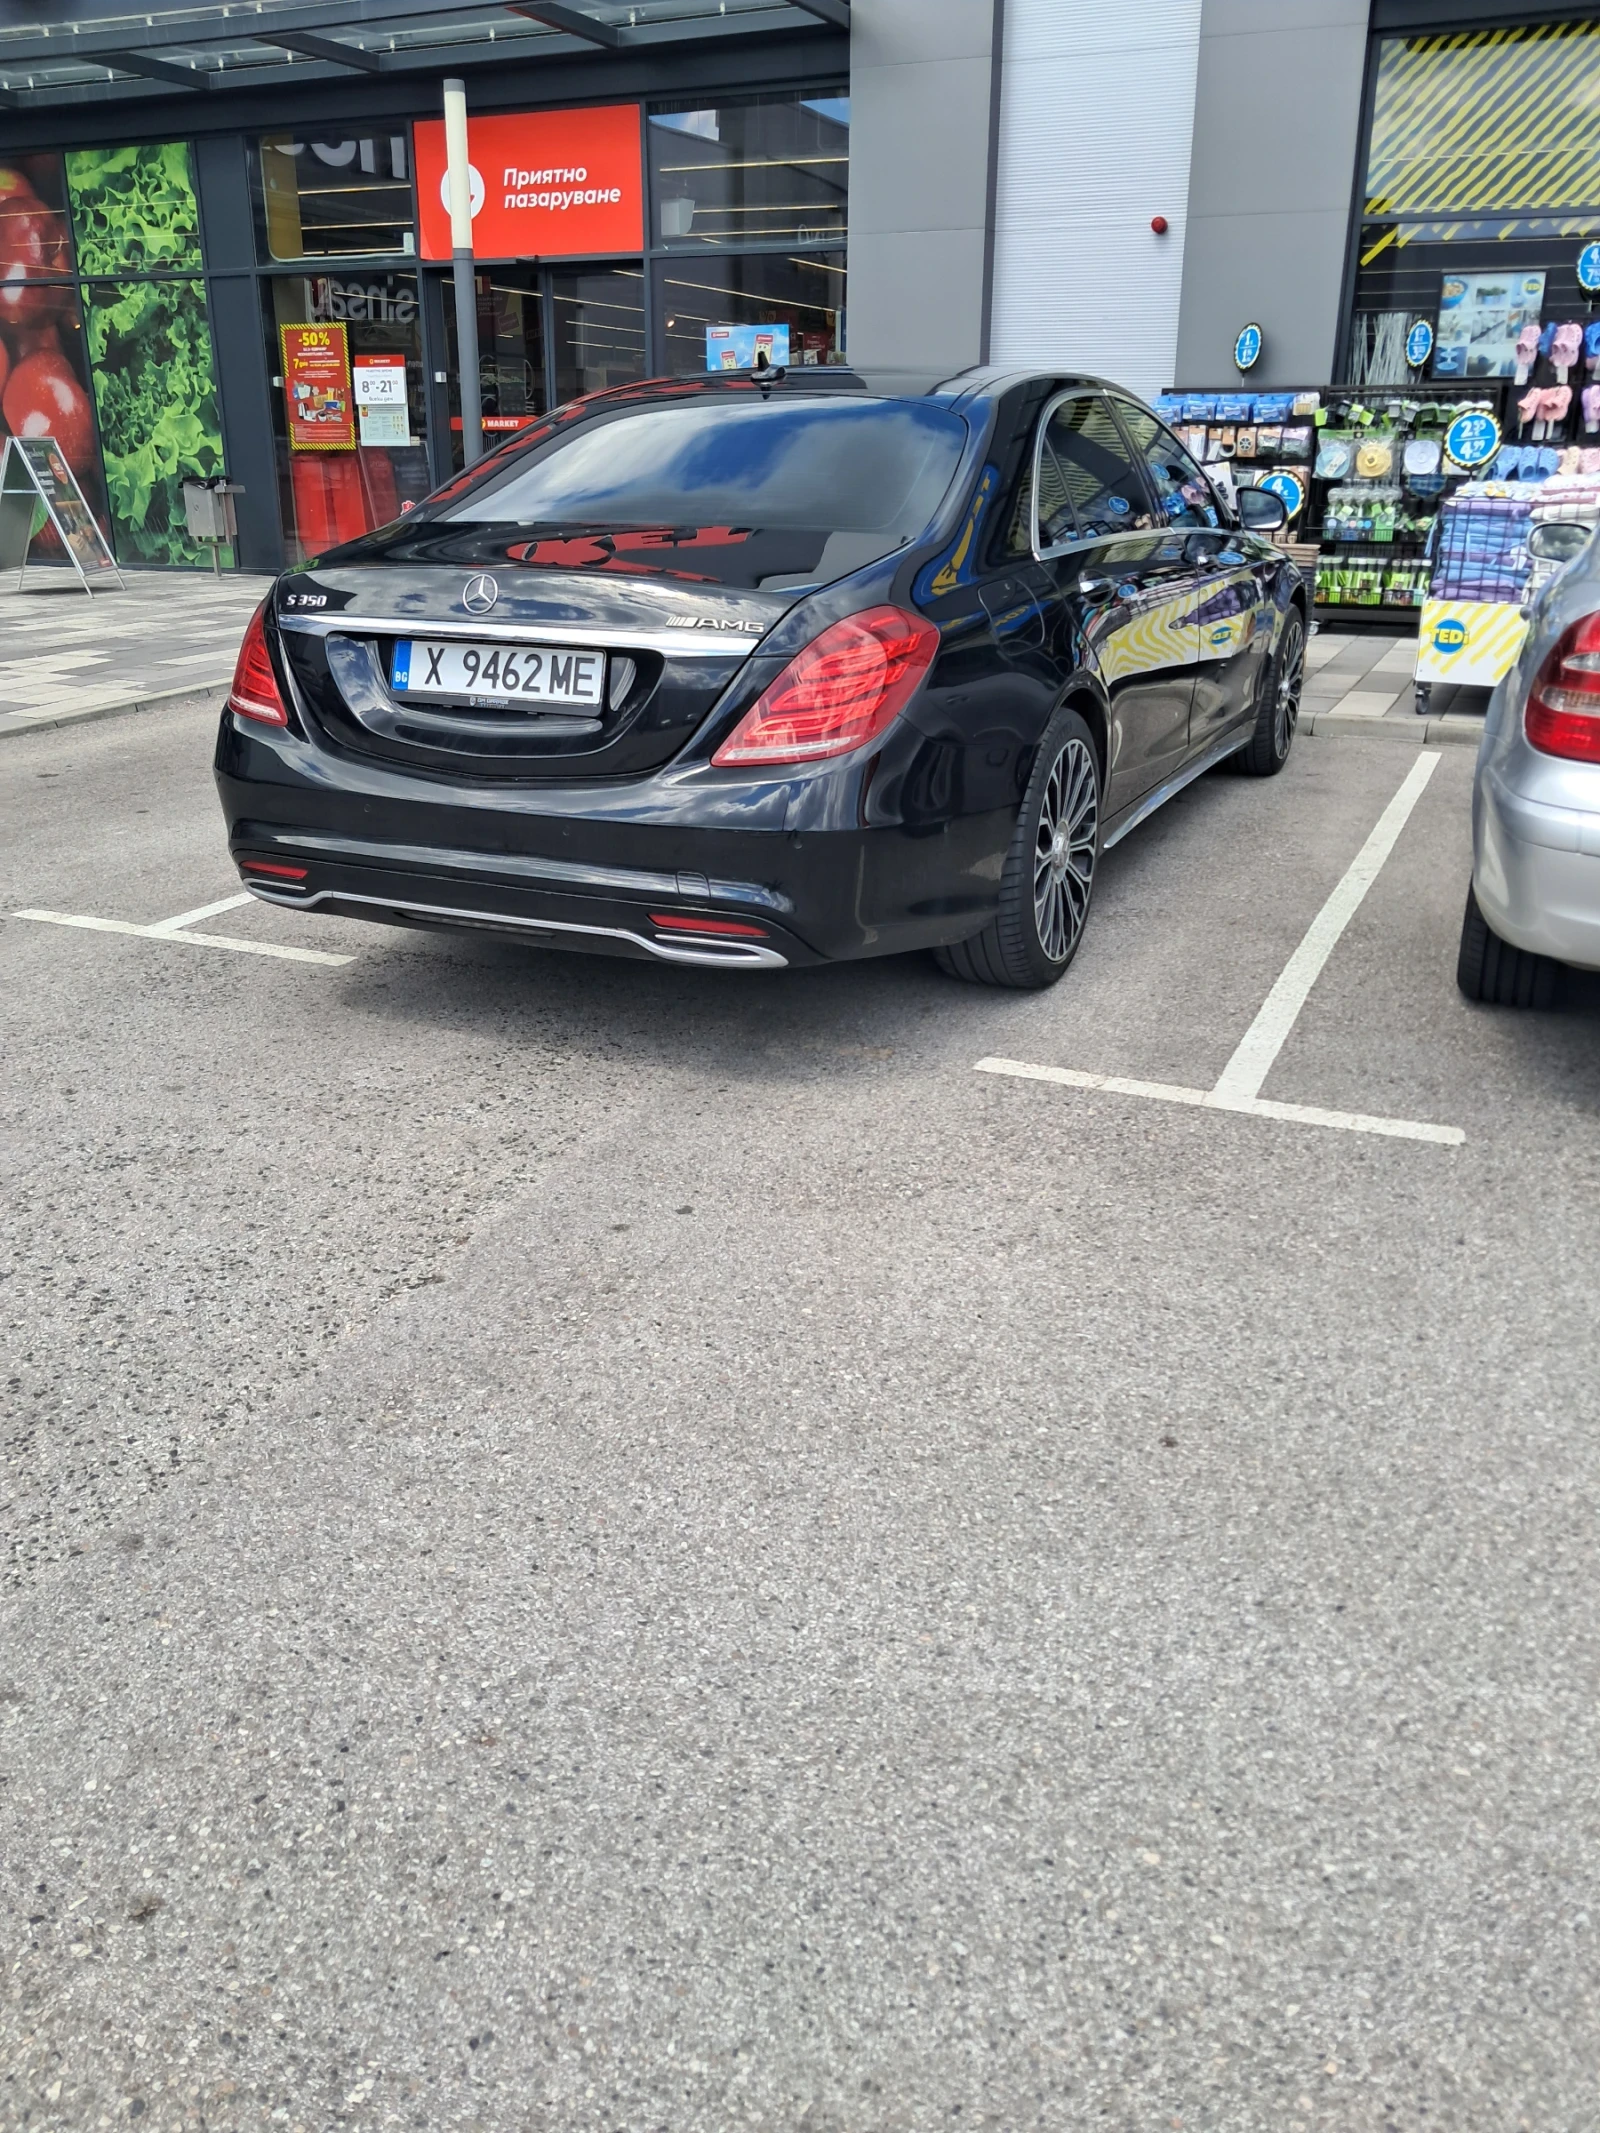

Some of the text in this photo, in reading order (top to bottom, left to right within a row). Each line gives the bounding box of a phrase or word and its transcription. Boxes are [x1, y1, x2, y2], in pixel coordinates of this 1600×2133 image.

[503, 167, 587, 190] Приятно
[504, 187, 622, 211] пазаруване
[298, 331, 330, 346] -50%
[487, 420, 519, 428] MARKET
[286, 594, 327, 607] S 350
[696, 618, 765, 633] AMG
[395, 671, 408, 683] BG
